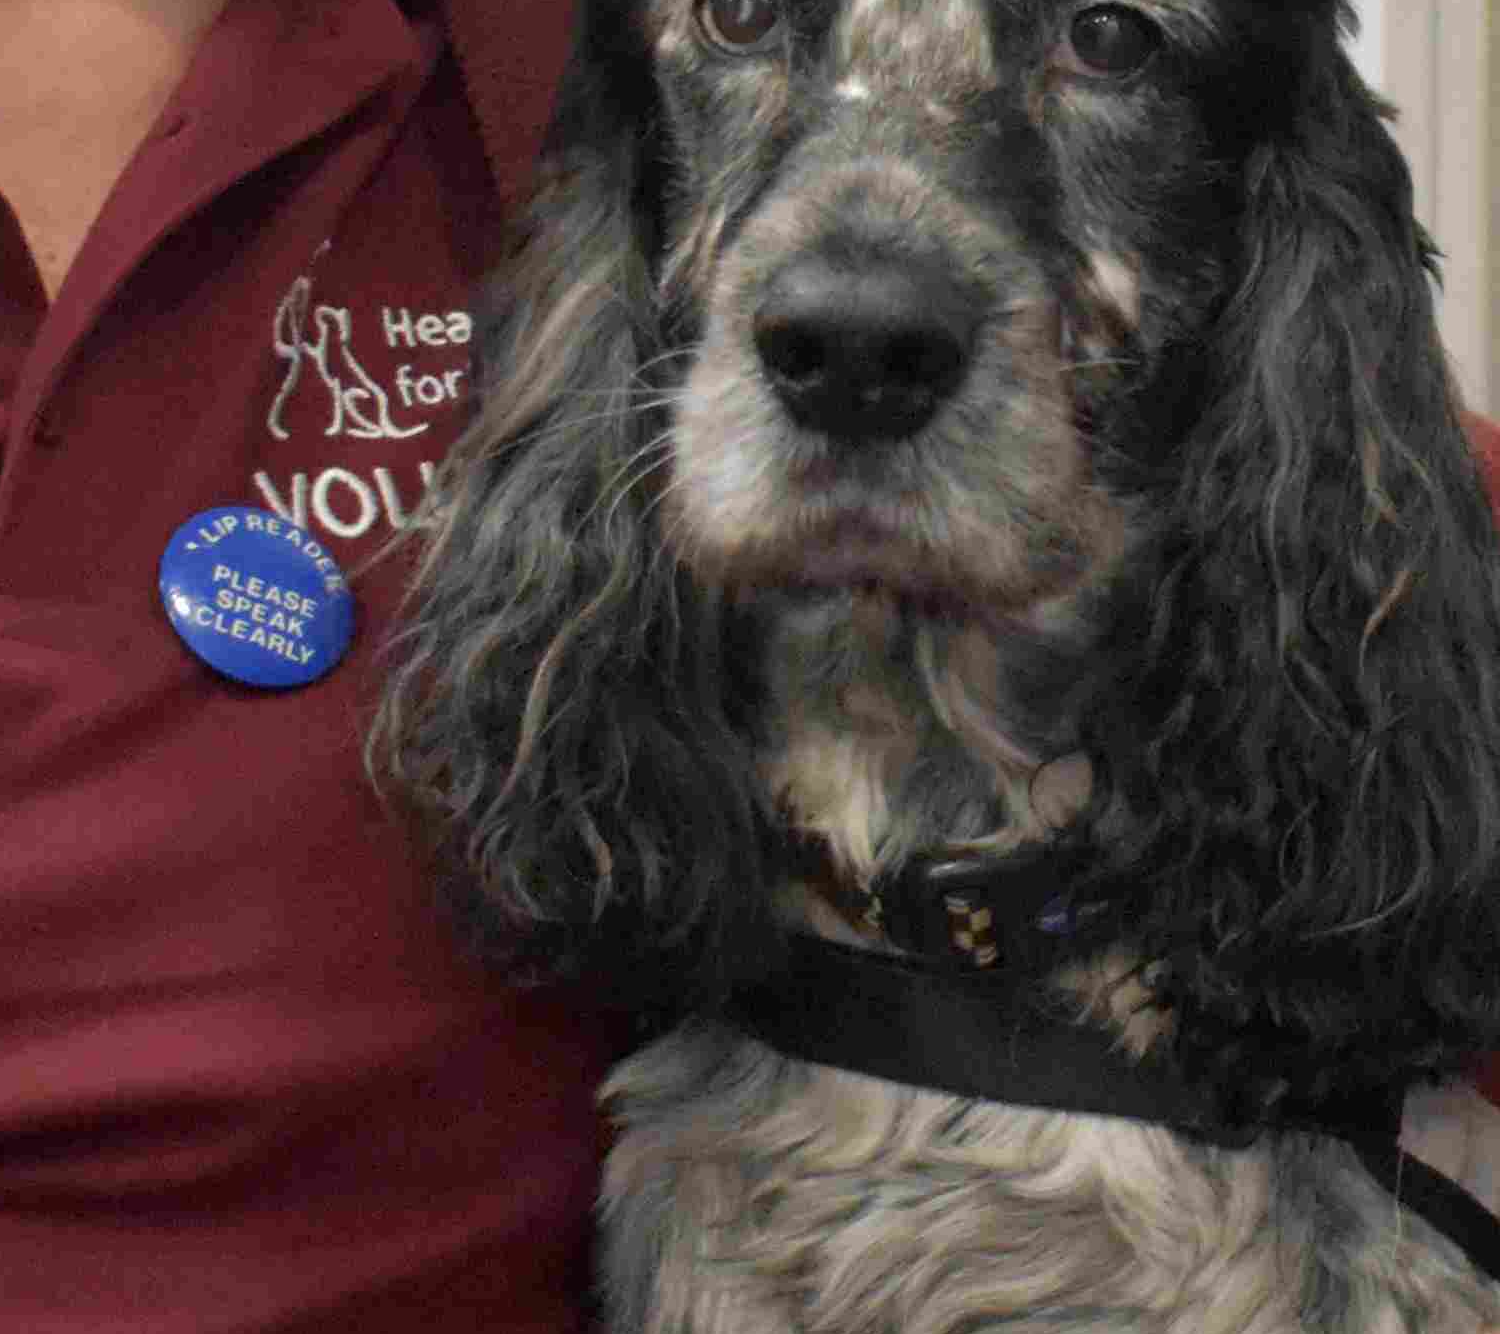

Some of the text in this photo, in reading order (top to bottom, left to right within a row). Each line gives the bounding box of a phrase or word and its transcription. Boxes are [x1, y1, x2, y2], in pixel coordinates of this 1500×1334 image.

[381, 307, 472, 347] Hea
[396, 364, 463, 407] for
[254, 461, 436, 540] VOL
[199, 514, 344, 592] LIP READER
[214, 564, 318, 618] PLEASE
[216, 589, 305, 638] SPEAK
[195, 605, 316, 664] CLEARLY
